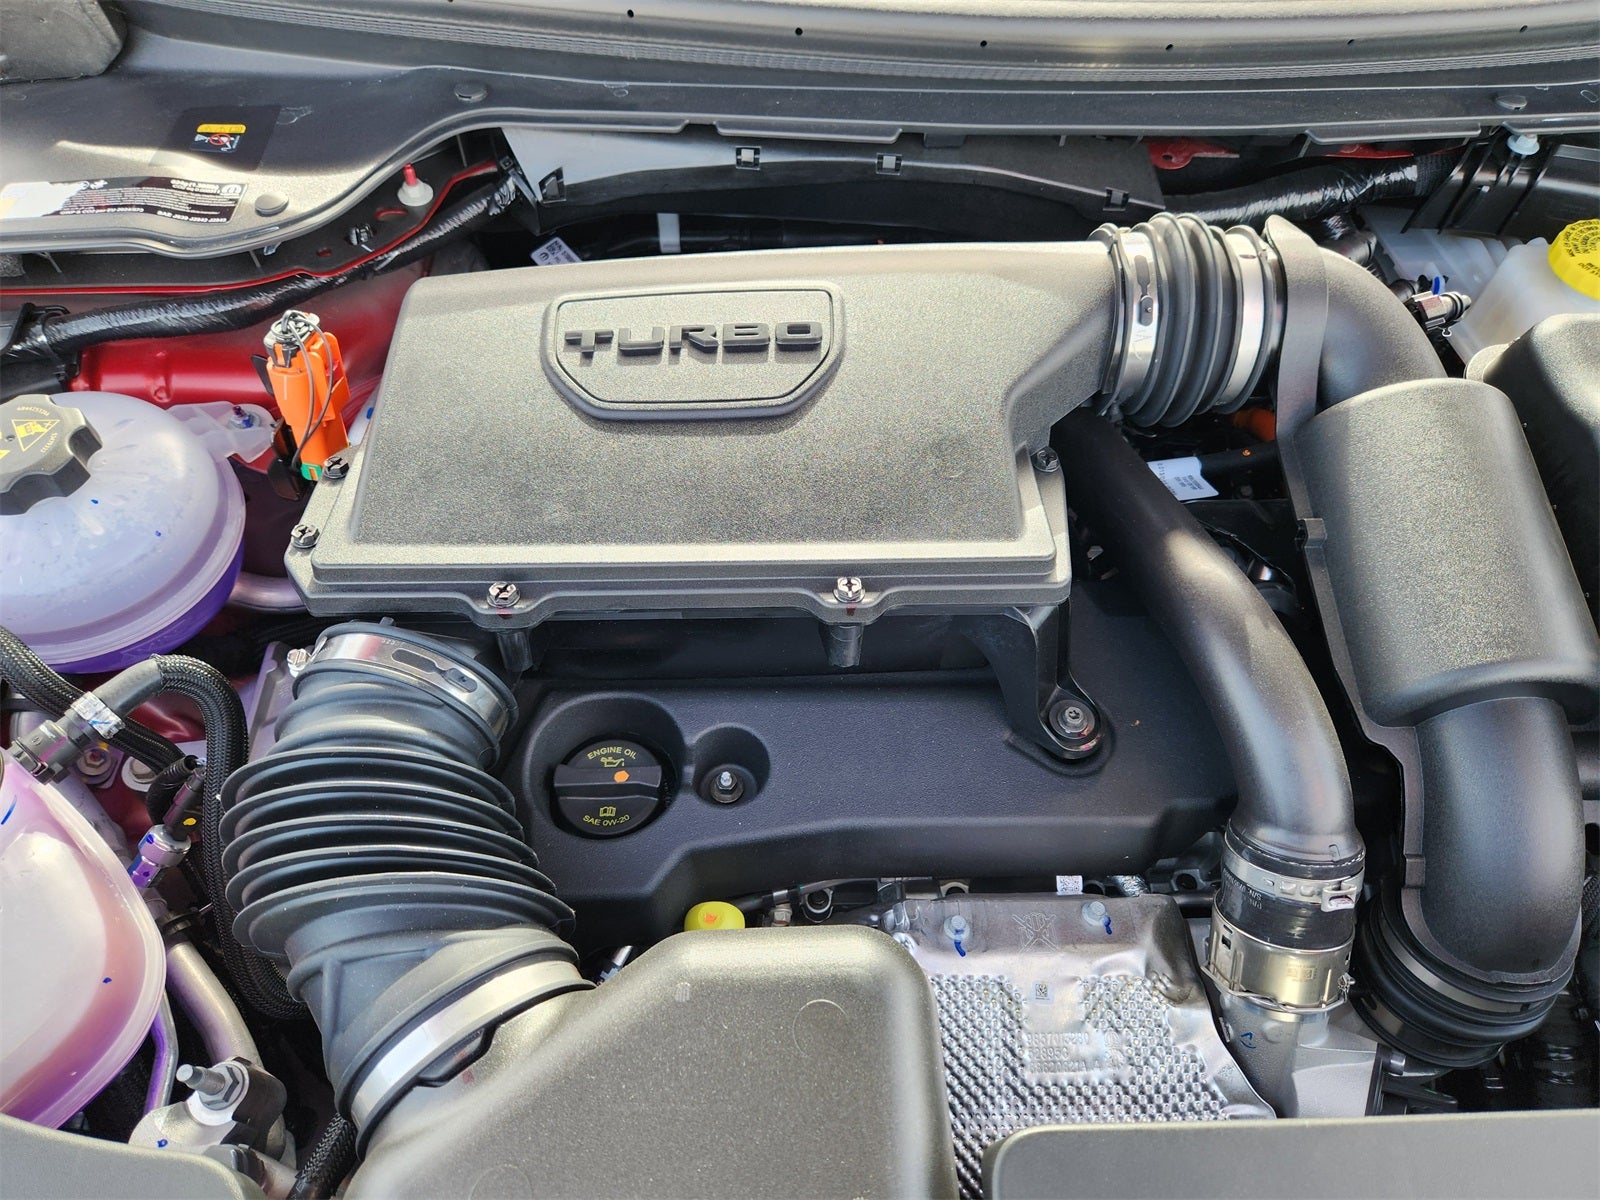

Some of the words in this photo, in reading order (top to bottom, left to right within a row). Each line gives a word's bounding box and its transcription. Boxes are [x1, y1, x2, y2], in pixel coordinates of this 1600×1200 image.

[564, 321, 823, 355] TURBO
[588, 747, 621, 759] ENGINE
[624, 749, 637, 759] OIL
[583, 815, 600, 825] SAE
[603, 815, 630, 826] 0W-20
